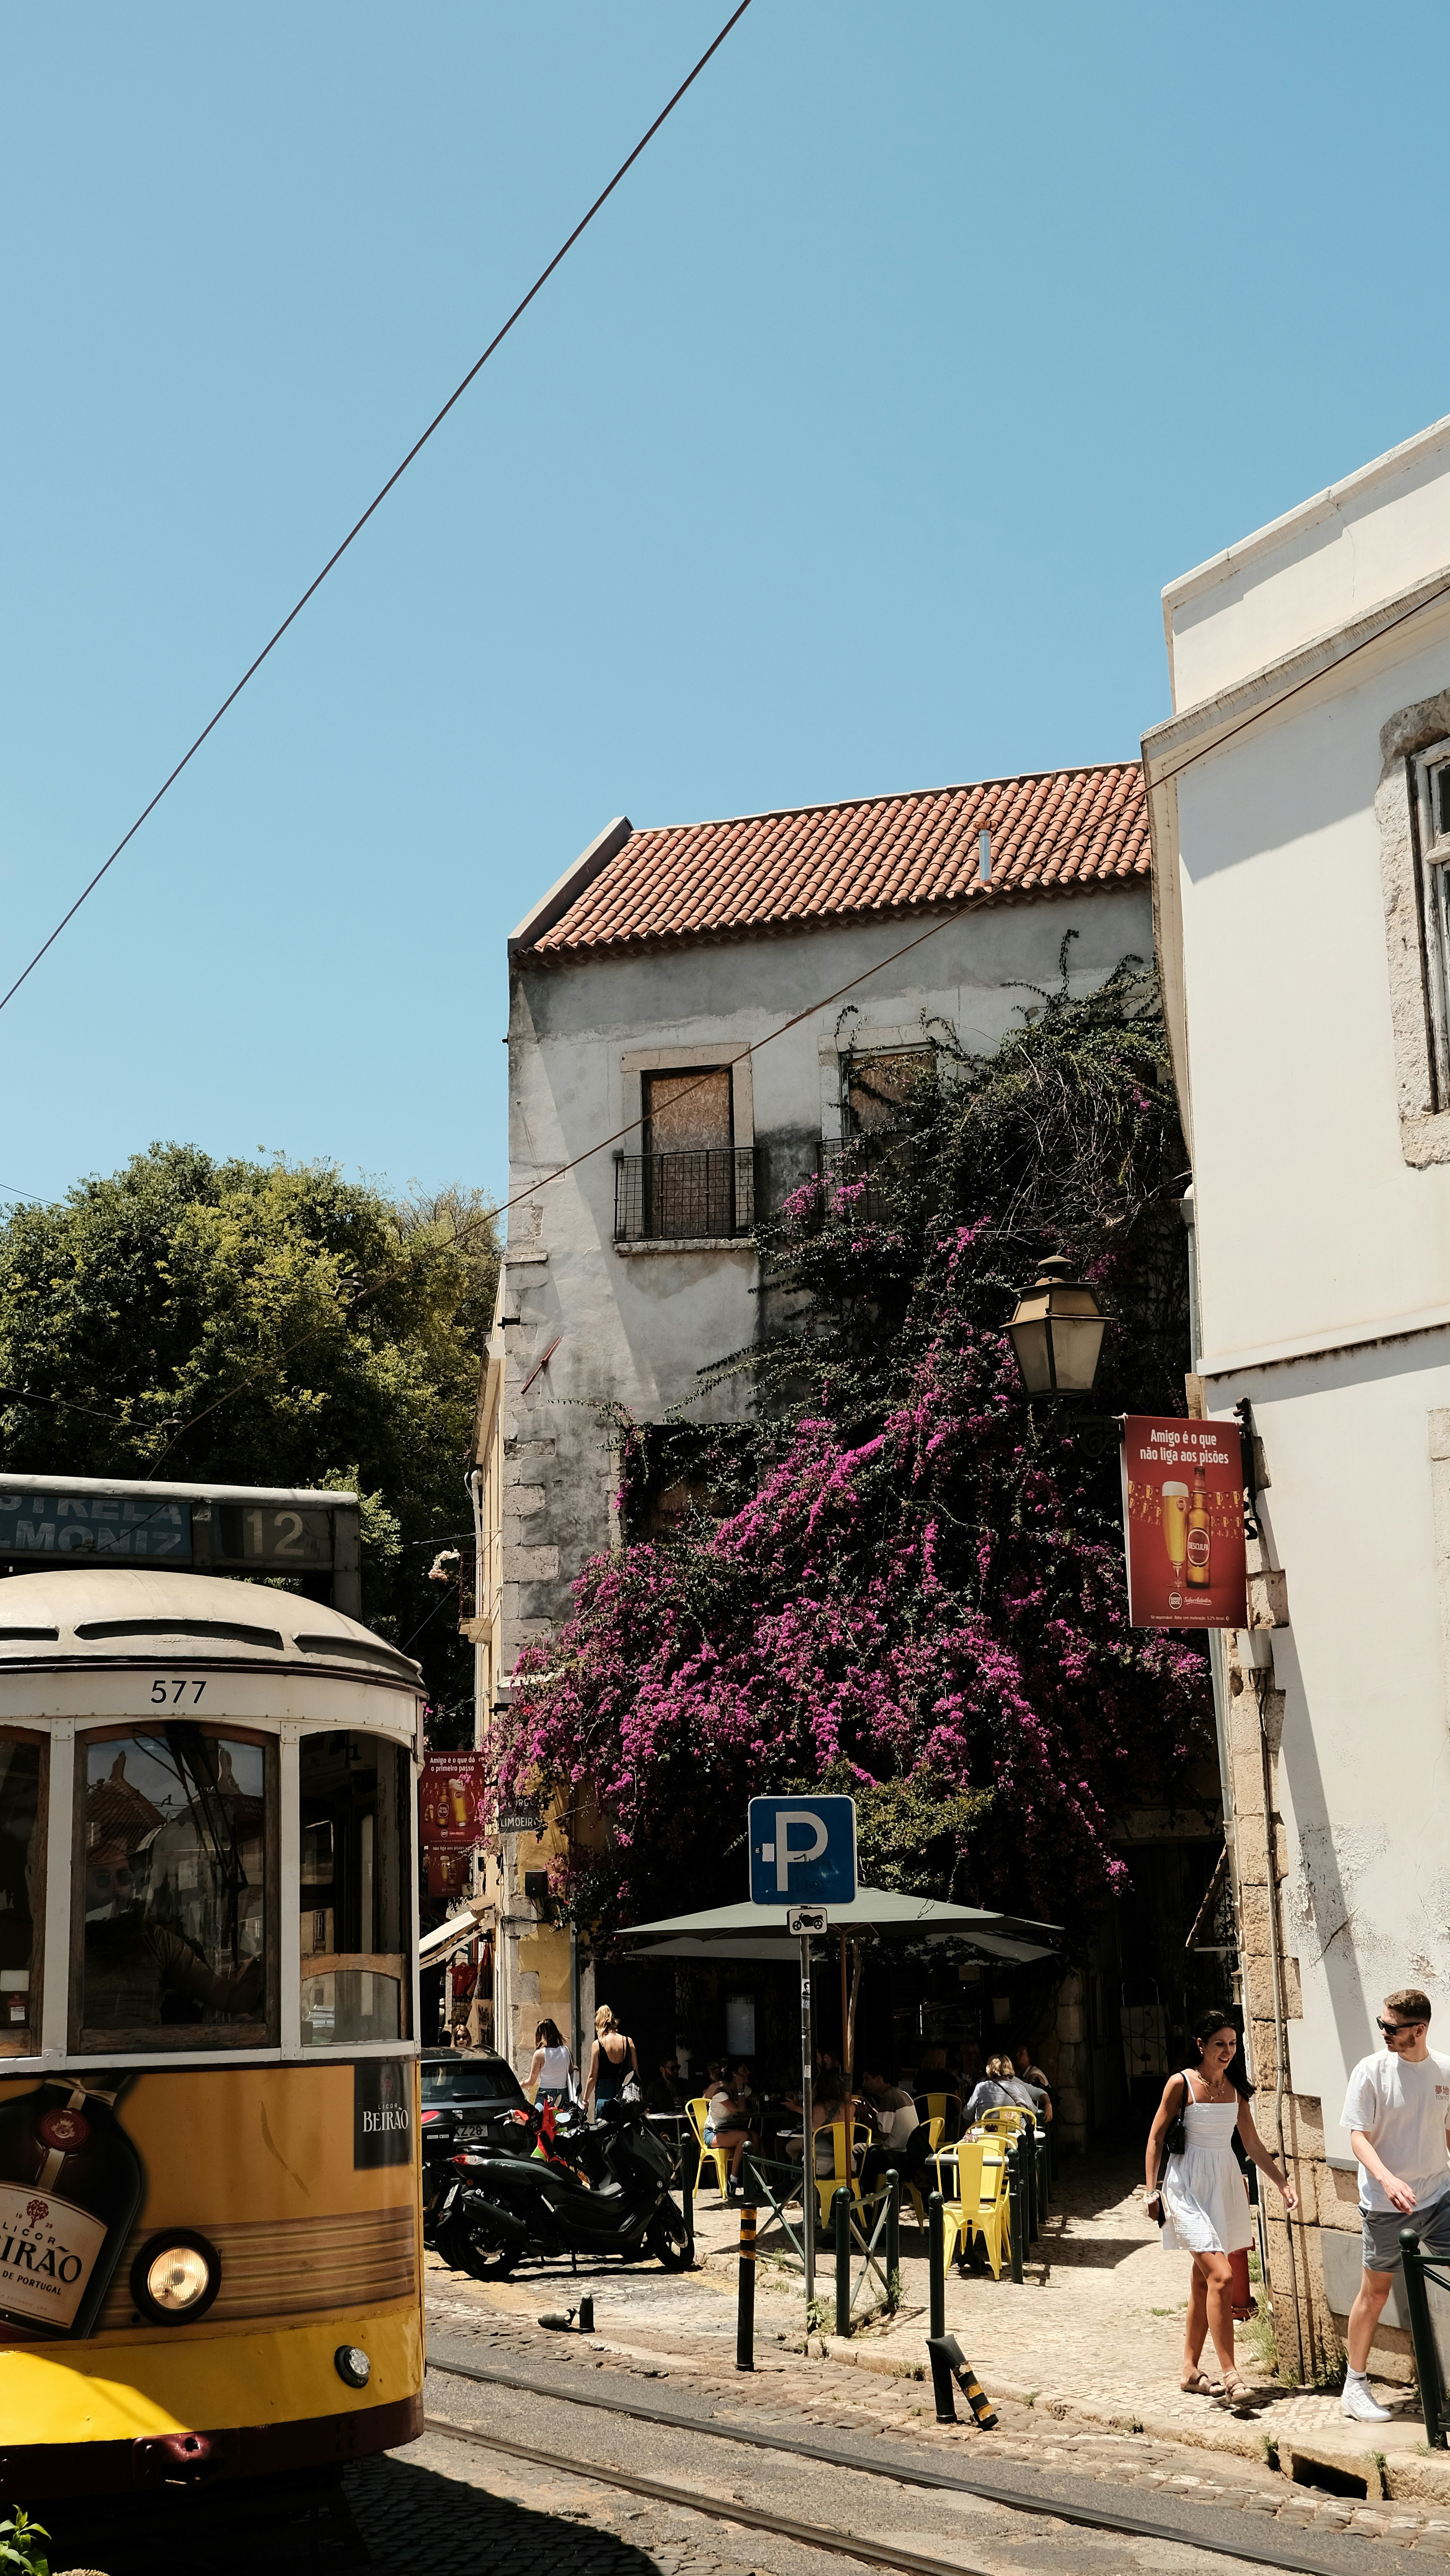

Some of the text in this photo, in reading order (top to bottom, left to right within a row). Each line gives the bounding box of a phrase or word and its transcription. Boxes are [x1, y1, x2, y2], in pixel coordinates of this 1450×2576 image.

[1150, 1429, 1216, 1449] Amigo é o que
[1140, 1447, 1229, 1466] não liga aos pisões
[246, 1511, 305, 1556] 12
[1188, 1542, 1208, 1551] DESCULPA
[151, 1680, 207, 1704] 577
[430, 1757, 446, 1765] Amigo
[776, 1811, 828, 1892] P
[362, 2107, 409, 2132] BEIRÃO
[3, 2221, 56, 2245] LICOR
[0, 2233, 83, 2284] IRÃO
[2, 2270, 62, 2295] DE PORTUGAL
